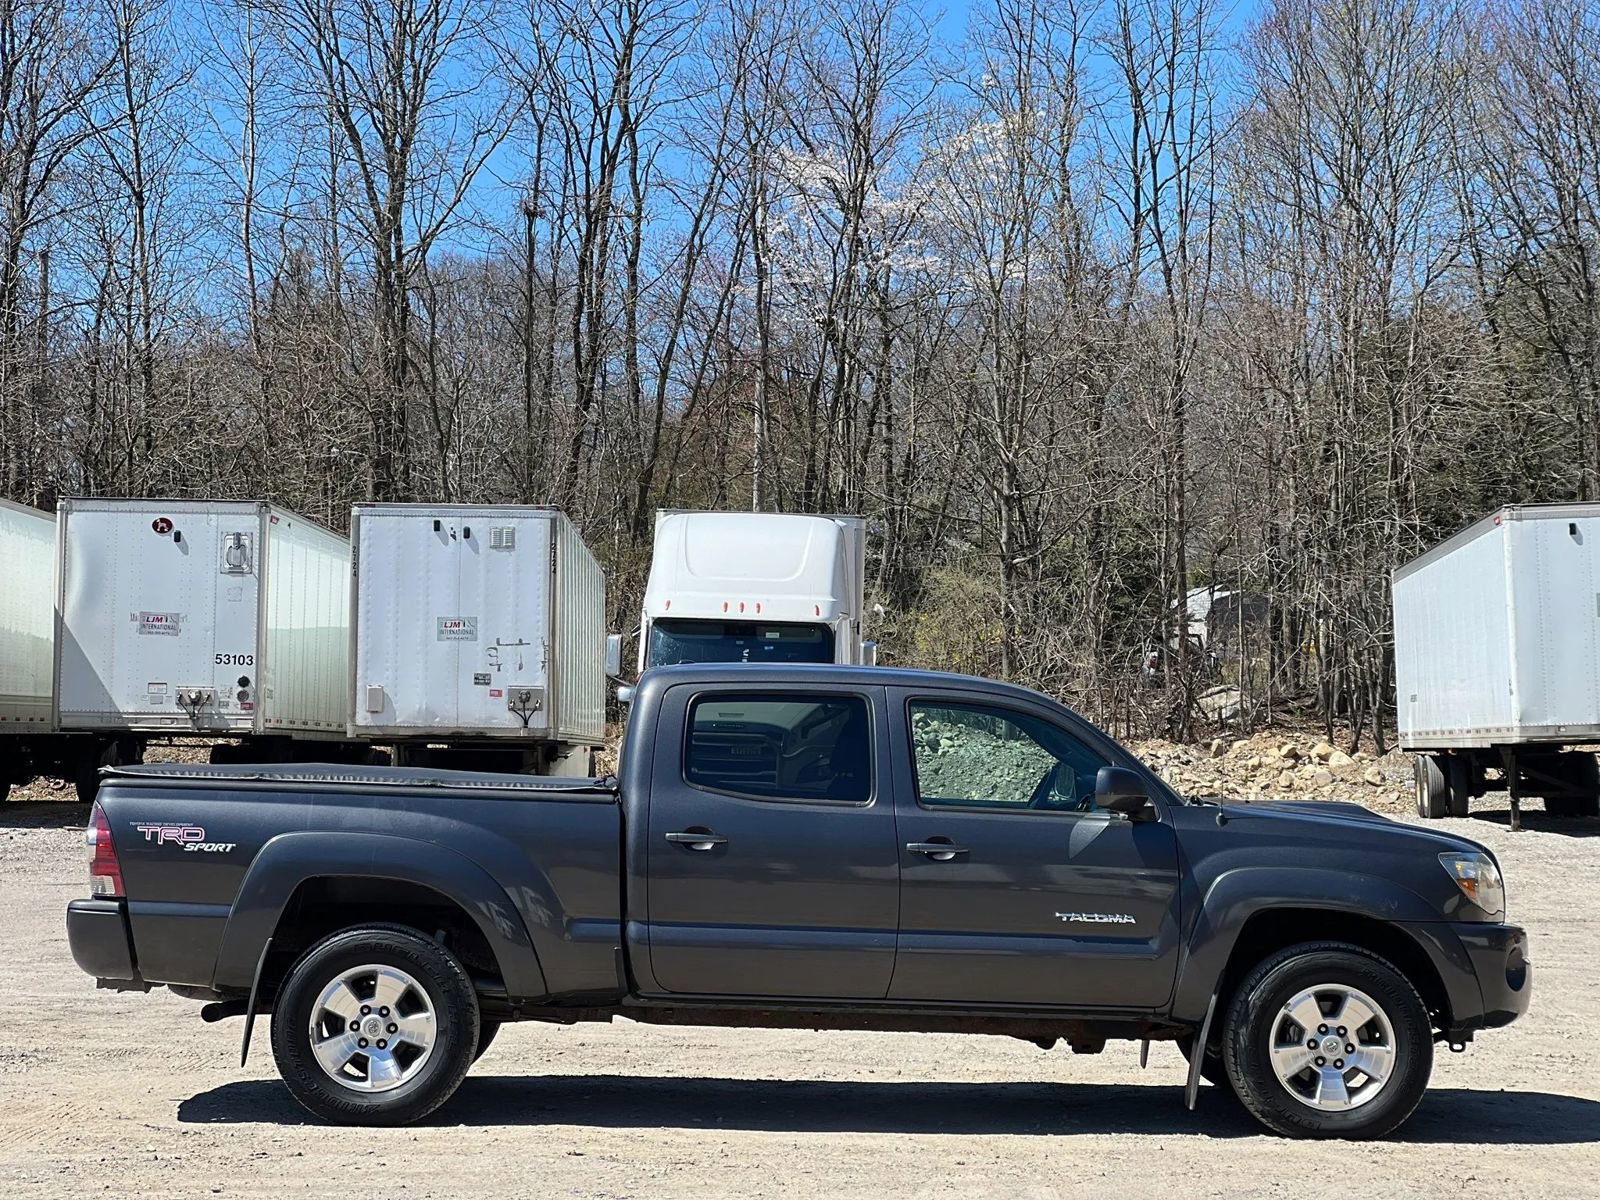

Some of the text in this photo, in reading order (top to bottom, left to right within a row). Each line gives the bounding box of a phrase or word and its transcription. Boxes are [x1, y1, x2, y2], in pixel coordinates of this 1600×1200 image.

[145, 615, 164, 623] LJM
[140, 623, 177, 631] INTERNATIONAL
[214, 653, 254, 666] 53103
[137, 826, 205, 845] TRD
[183, 842, 235, 853] SPORT
[1055, 912, 1136, 923] TACOMA
